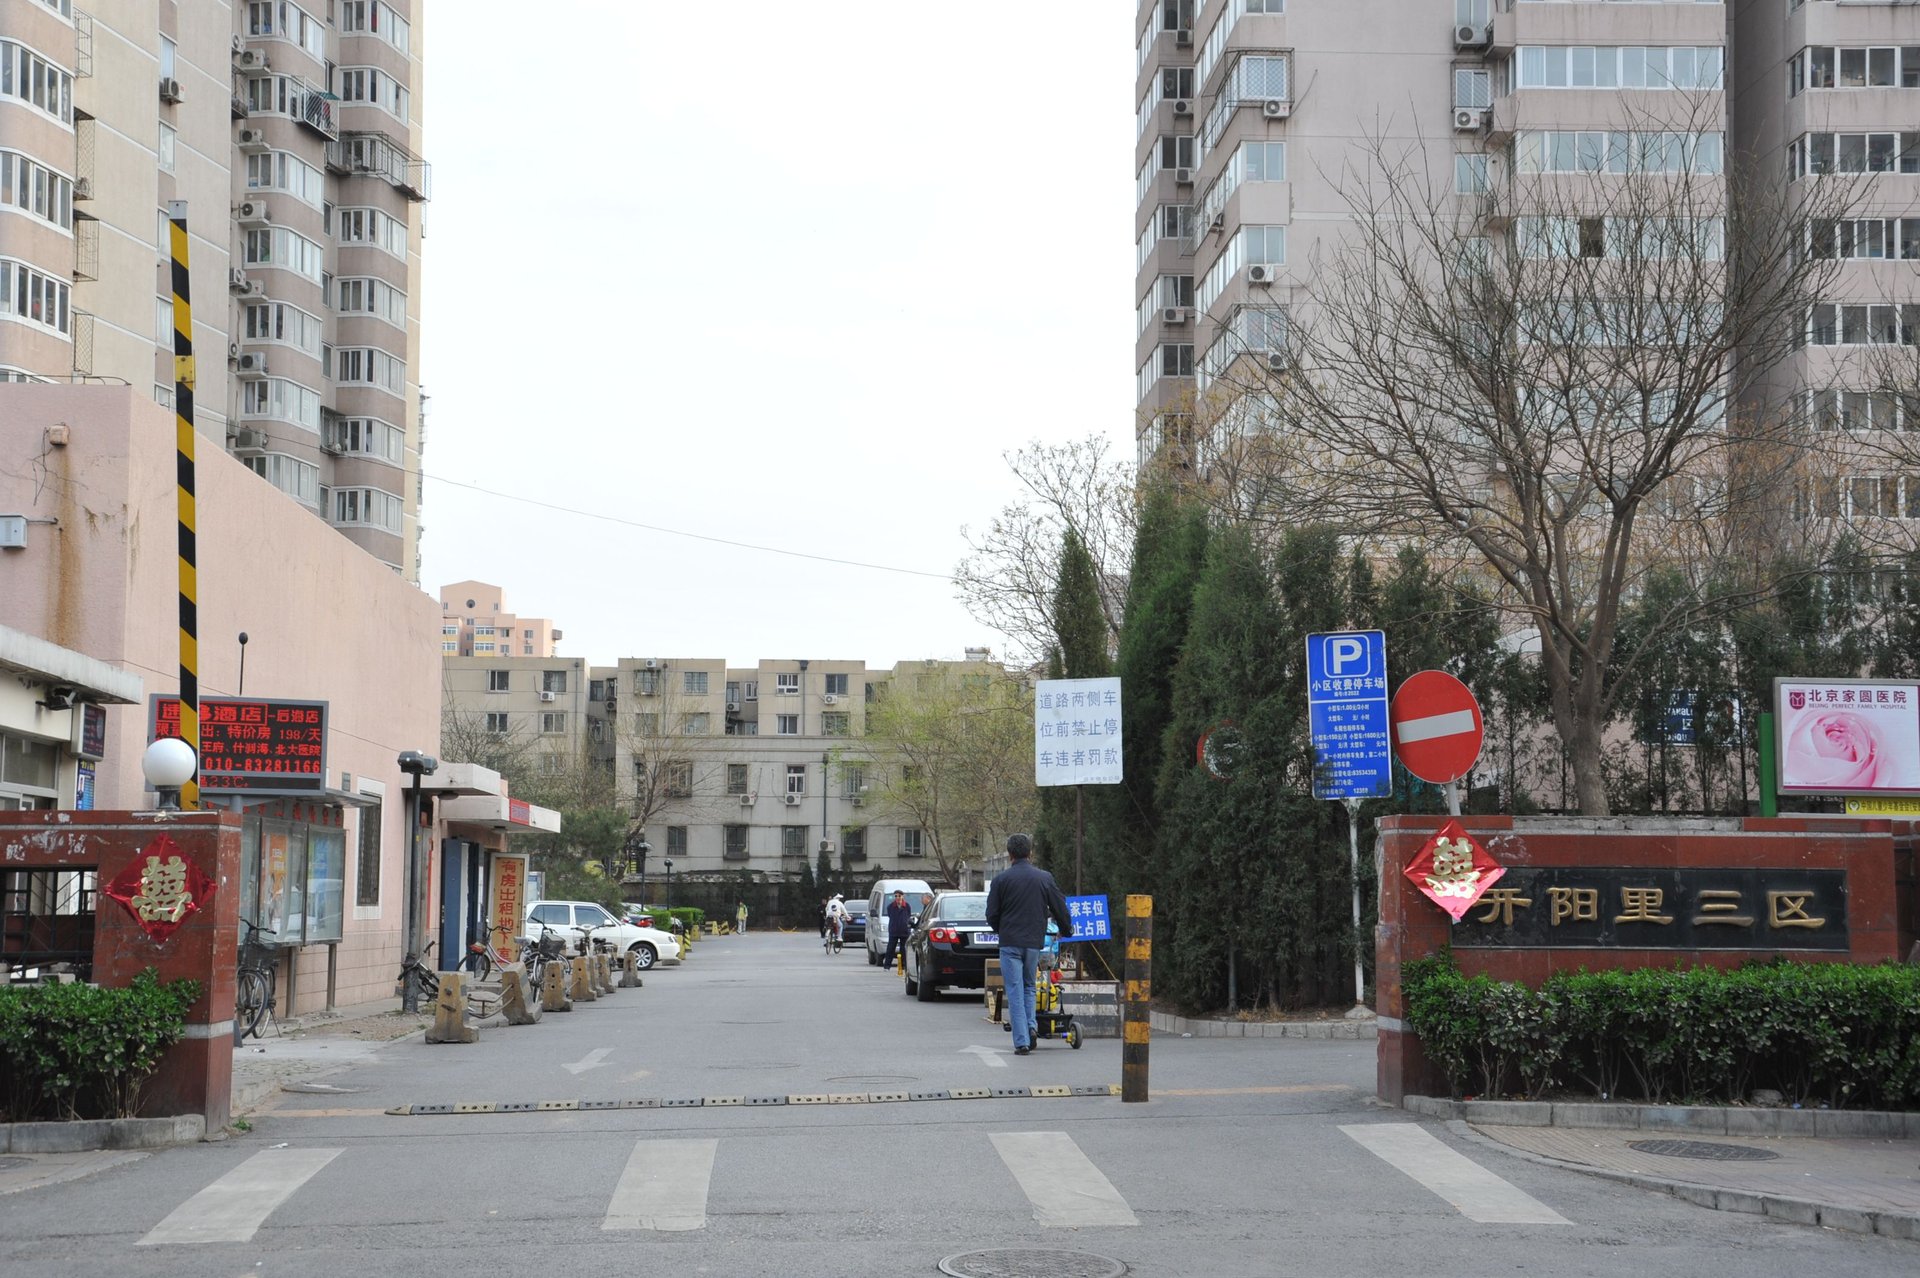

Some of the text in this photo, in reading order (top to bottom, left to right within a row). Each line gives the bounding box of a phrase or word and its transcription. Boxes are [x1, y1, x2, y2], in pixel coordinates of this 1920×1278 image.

[1332, 638, 1363, 674] P
[1312, 677, 1384, 692] 小区收费停车场
[1039, 689, 1117, 709] 道路两侧车
[1808, 689, 1907, 704] 北京家圆医院
[279, 728, 321, 741] 198/天
[1040, 718, 1118, 738] 位前禁止停
[201, 741, 321, 756] 王府、什刹海、北大医院
[1039, 747, 1118, 768] 车违者罚款
[205, 757, 321, 773] 010-83281166
[496, 860, 517, 963] 有房出租地下室
[1066, 900, 1105, 917] 家车位
[1473, 886, 1827, 928] 开阳里三区
[1071, 919, 1107, 937] 止占用
